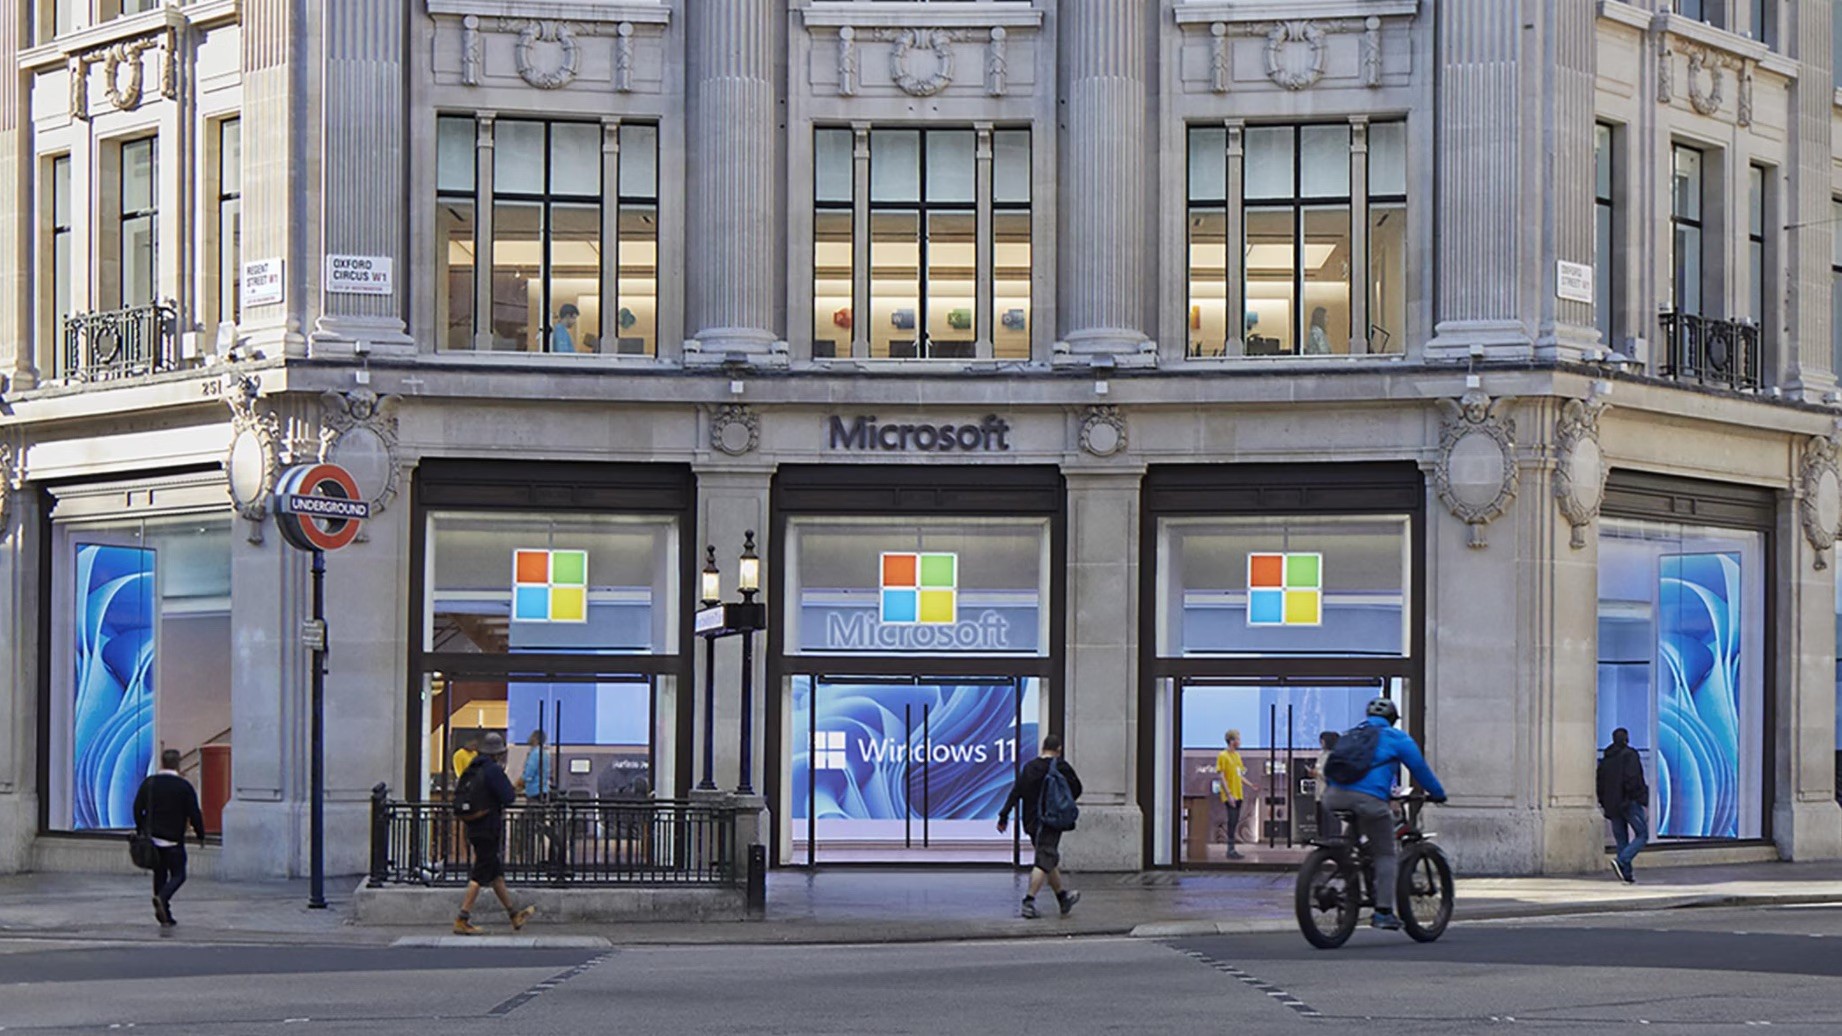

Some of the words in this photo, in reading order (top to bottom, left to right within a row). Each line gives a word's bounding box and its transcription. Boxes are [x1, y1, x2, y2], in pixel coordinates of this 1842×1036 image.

[247, 263, 268, 275] REGENT
[333, 259, 372, 270] OXFORD
[247, 275, 267, 287] STREET
[333, 270, 369, 281] CIRCUS
[372, 272, 387, 282] W1
[202, 380, 221, 396] 251
[829, 414, 1010, 451] Microsoft
[293, 498, 366, 515] UNDERGROUND
[827, 610, 1010, 650] Microsoft
[858, 738, 987, 763] Windows
[994, 738, 1016, 763] 11
